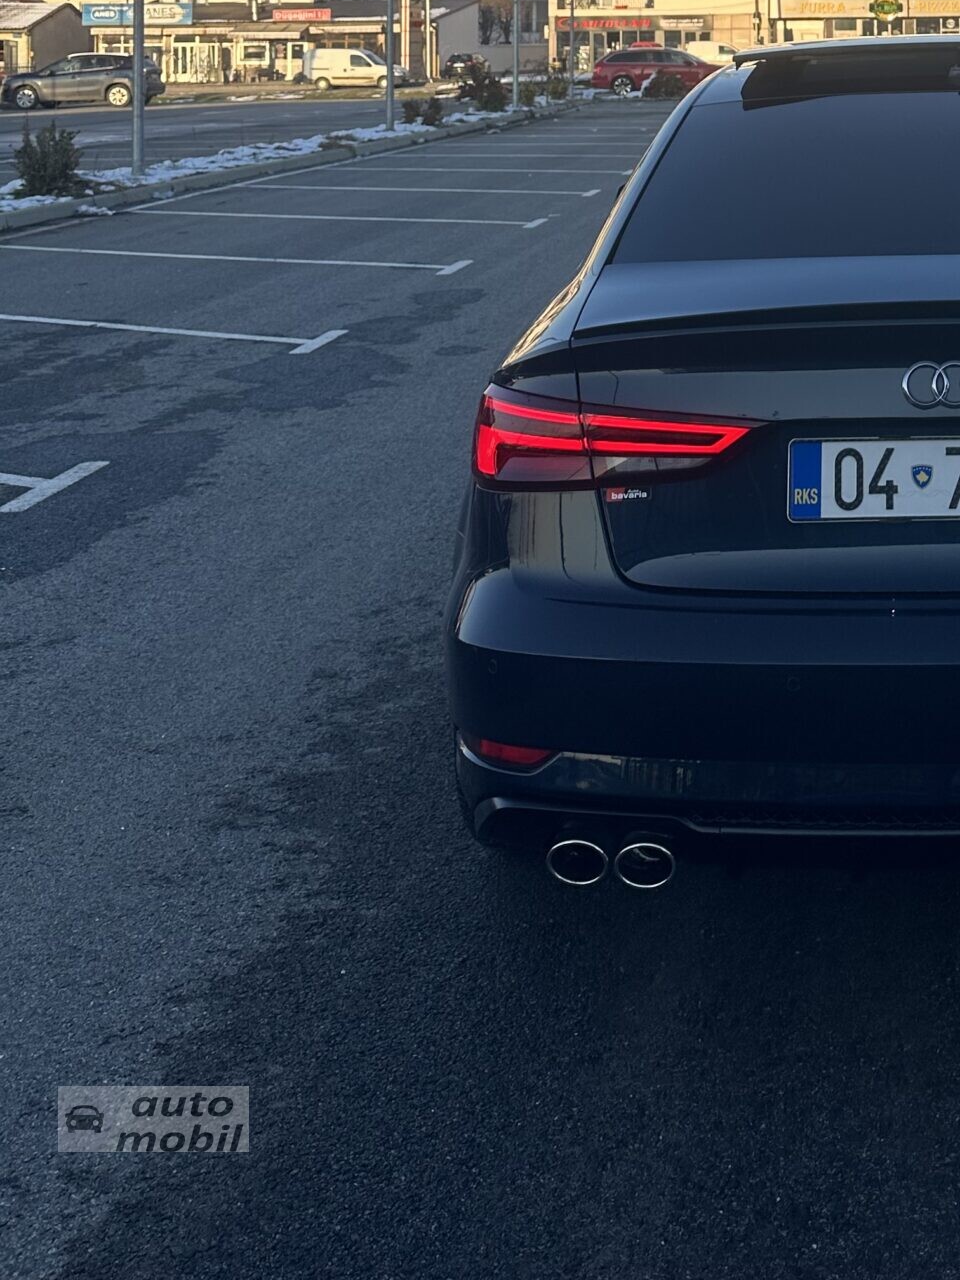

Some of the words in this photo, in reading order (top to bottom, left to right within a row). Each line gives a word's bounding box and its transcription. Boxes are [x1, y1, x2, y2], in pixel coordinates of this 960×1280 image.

[834, 447, 899, 511] 04
[611, 490, 648, 500] bavaria
[794, 488, 818, 505] RKS
